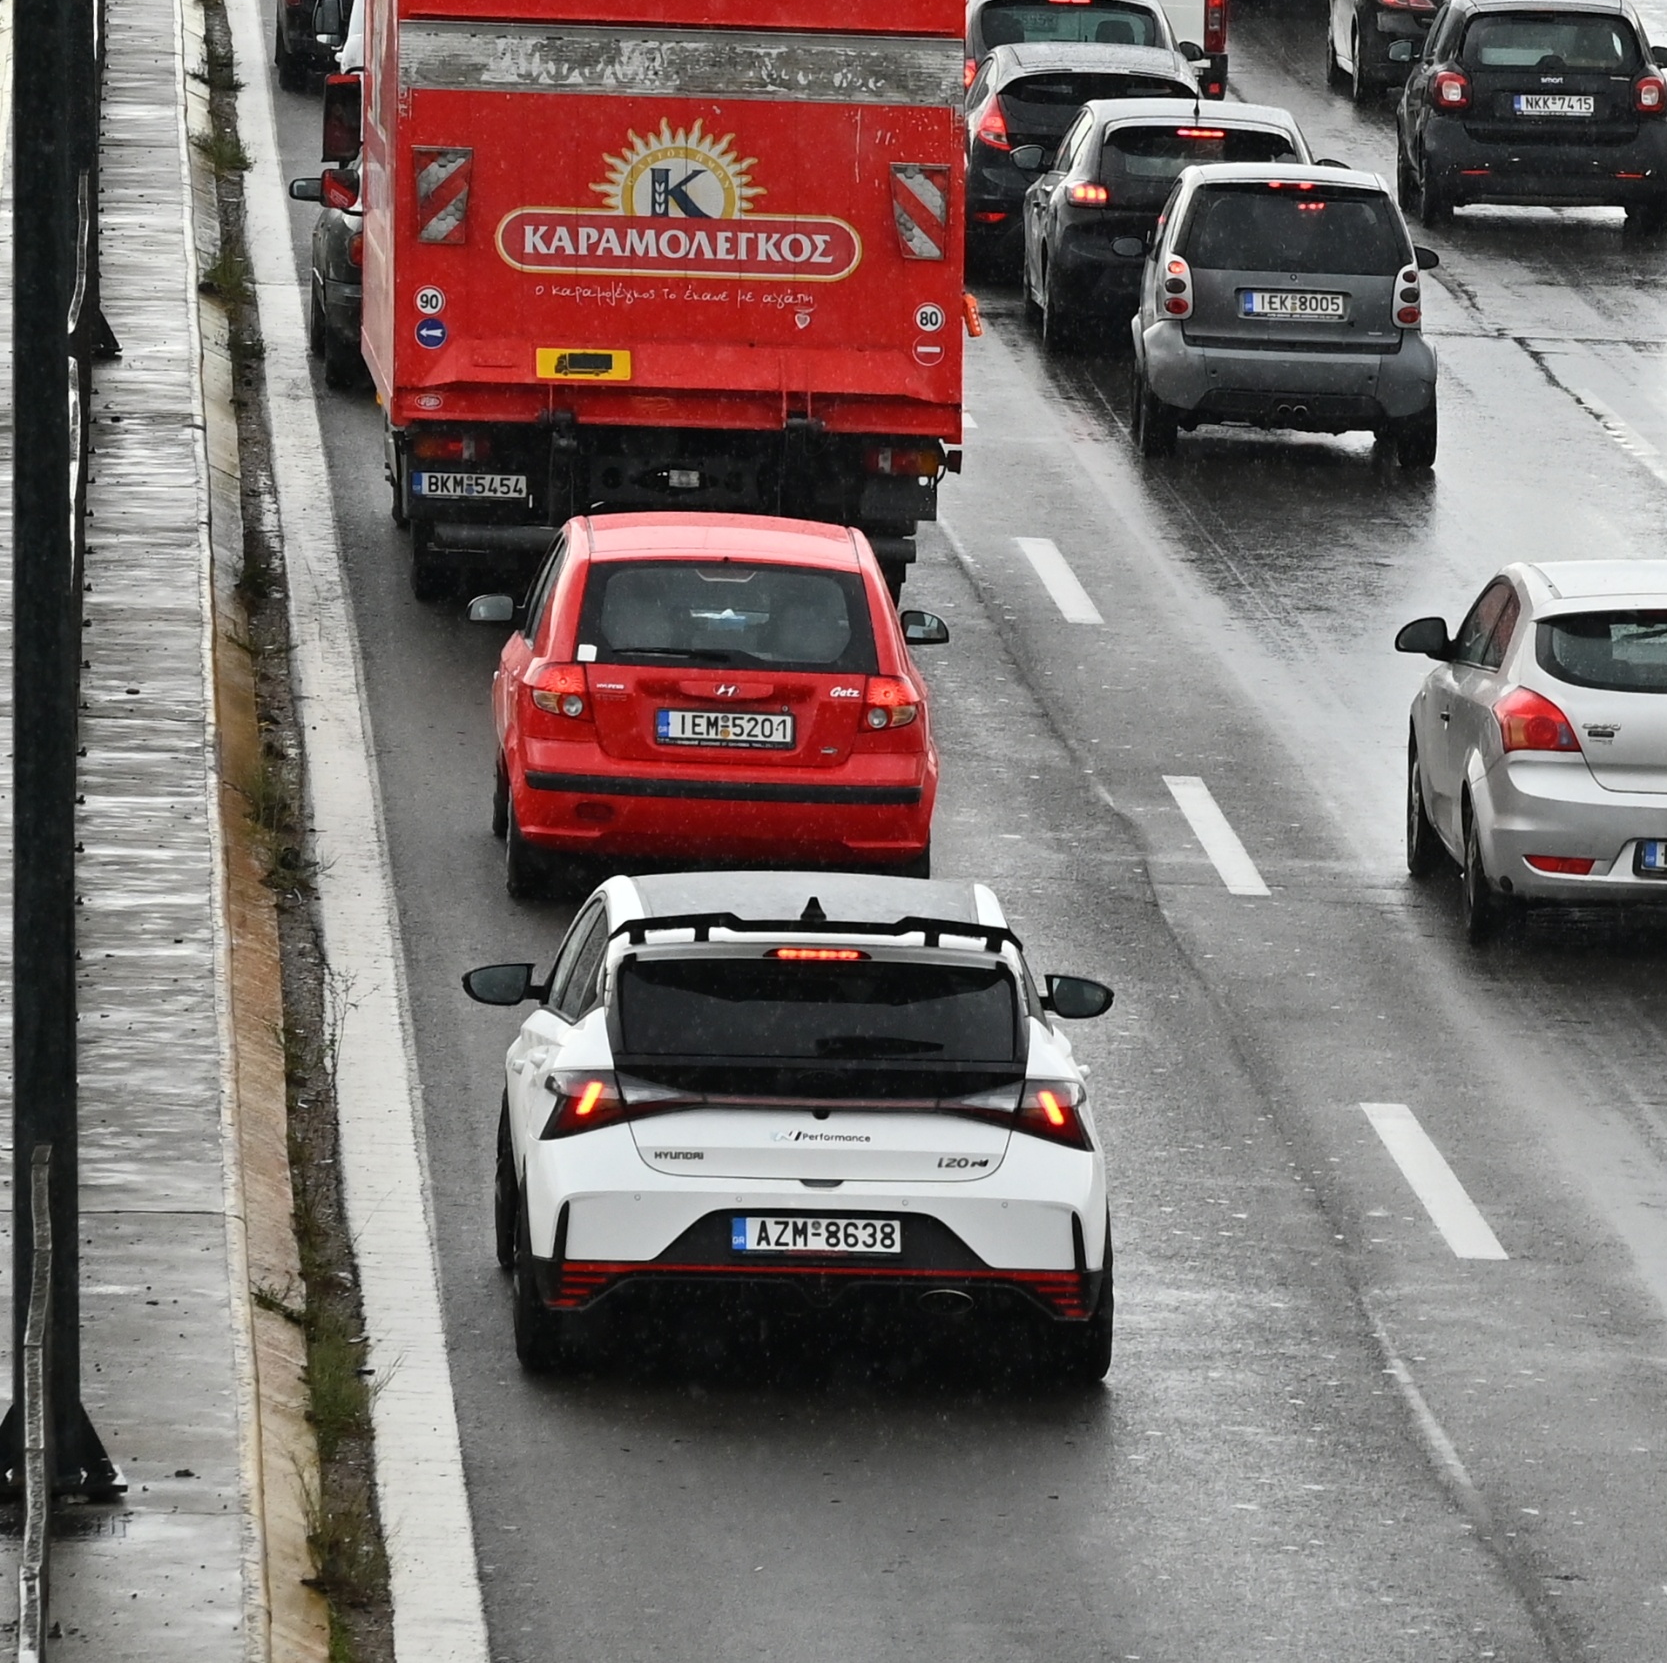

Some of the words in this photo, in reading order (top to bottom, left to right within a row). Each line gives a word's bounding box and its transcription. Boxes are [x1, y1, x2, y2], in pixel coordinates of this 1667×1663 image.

[1541, 76, 1564, 84] smart
[523, 224, 835, 265] ΚΑΡΑΜΟΛΕΓΚΟΣ
[419, 293, 440, 310] 90
[684, 286, 729, 303] έκανε
[738, 288, 755, 308] με
[919, 311, 940, 327] 80
[428, 475, 524, 497] BKM-5454
[830, 686, 860, 698] Getz
[803, 1132, 872, 1143] Performance
[655, 1151, 705, 1160] HYUNDAI
[756, 1220, 897, 1249] AZM-8638
